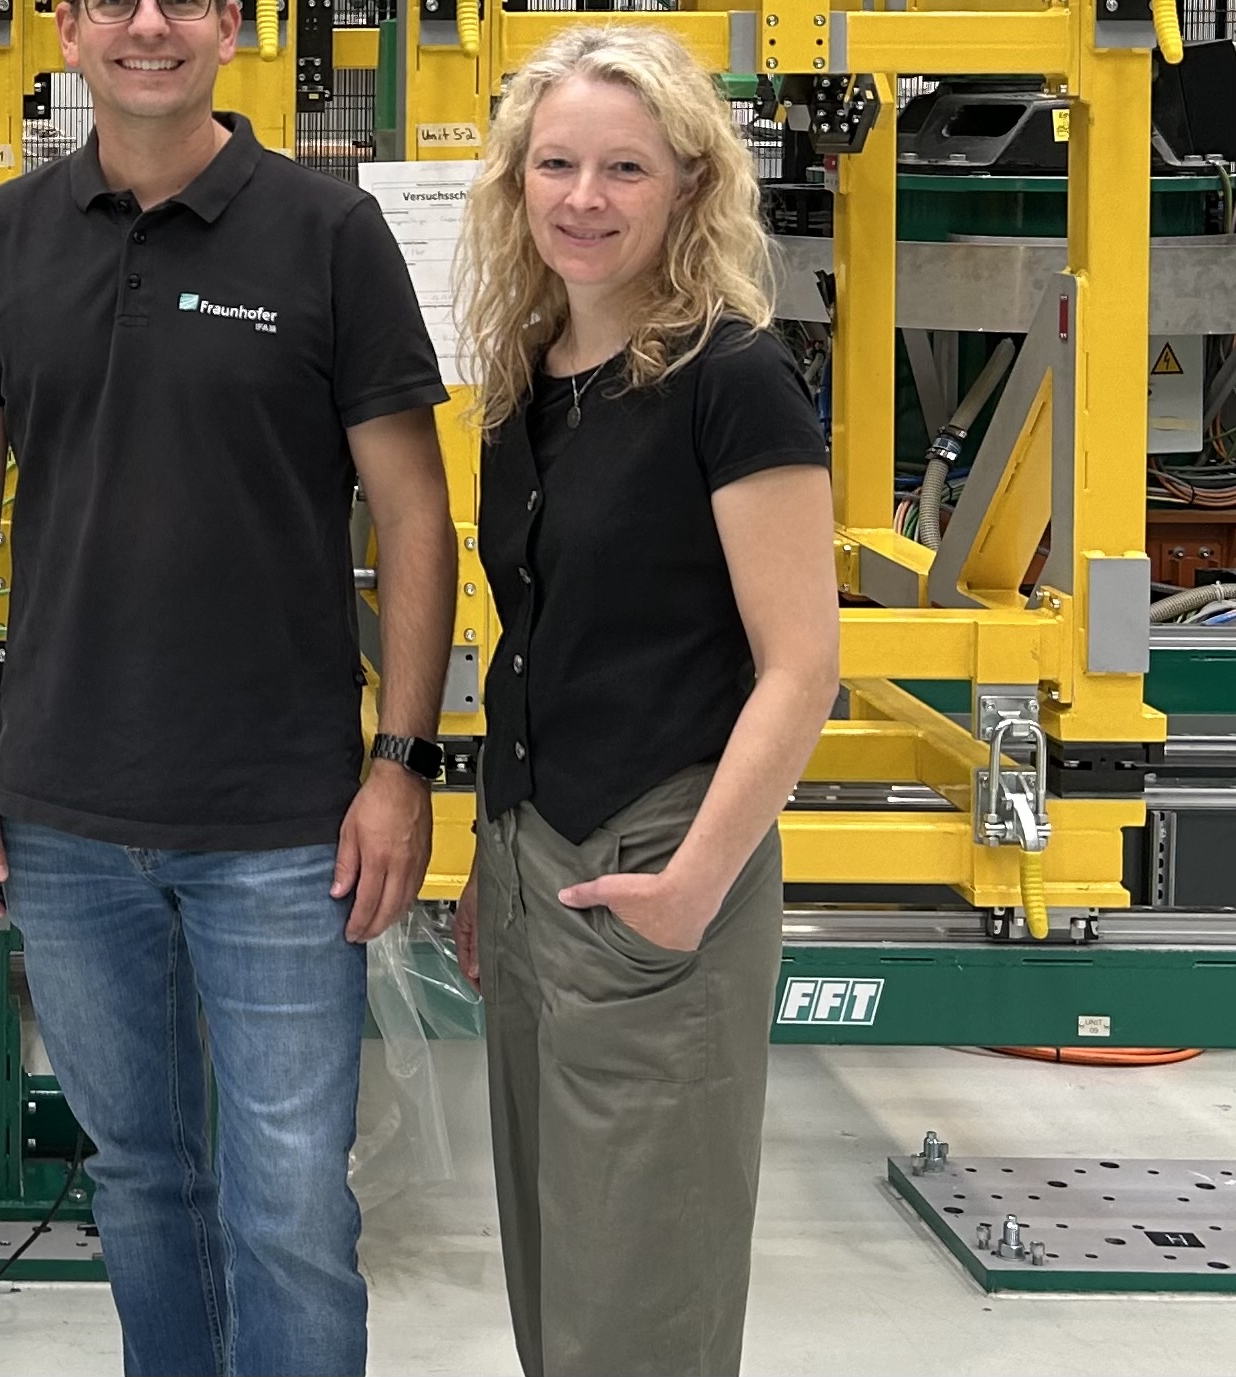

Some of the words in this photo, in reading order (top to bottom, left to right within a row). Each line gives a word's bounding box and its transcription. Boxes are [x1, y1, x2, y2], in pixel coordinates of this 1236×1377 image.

[421, 128, 449, 141] Unit
[200, 300, 278, 322] Fraunhofer
[782, 982, 878, 1020] FFT
[1165, 1233, 1189, 1246] H
